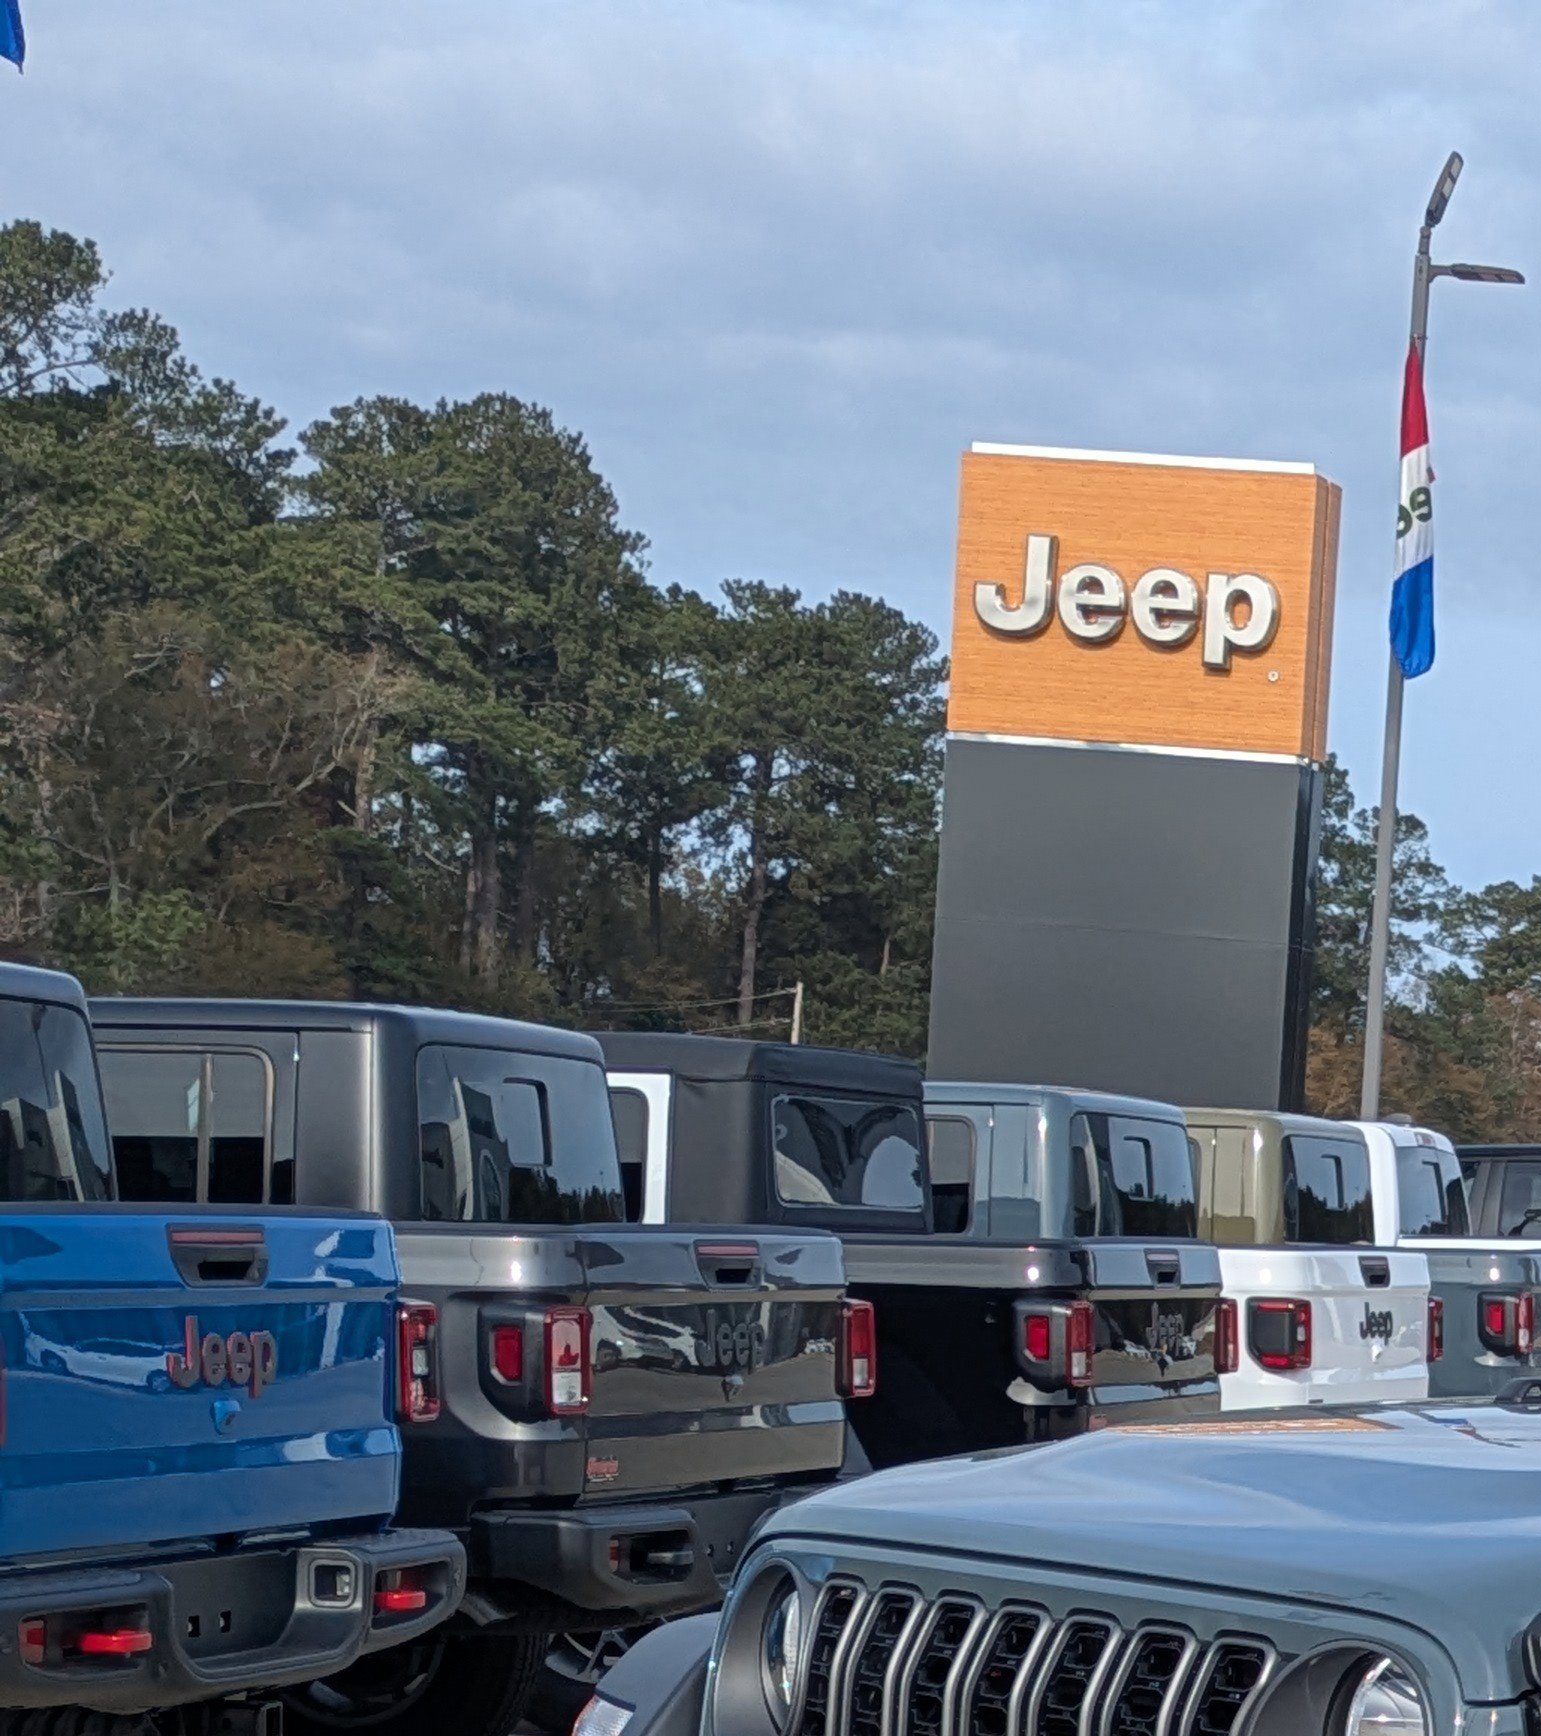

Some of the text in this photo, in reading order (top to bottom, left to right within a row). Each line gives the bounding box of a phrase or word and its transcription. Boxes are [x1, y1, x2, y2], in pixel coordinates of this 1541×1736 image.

[974, 532, 1280, 672] Jeep
[165, 1314, 278, 1400] Jeep
[694, 1308, 766, 1375] Jeep
[1360, 1301, 1394, 1346] Jeep
